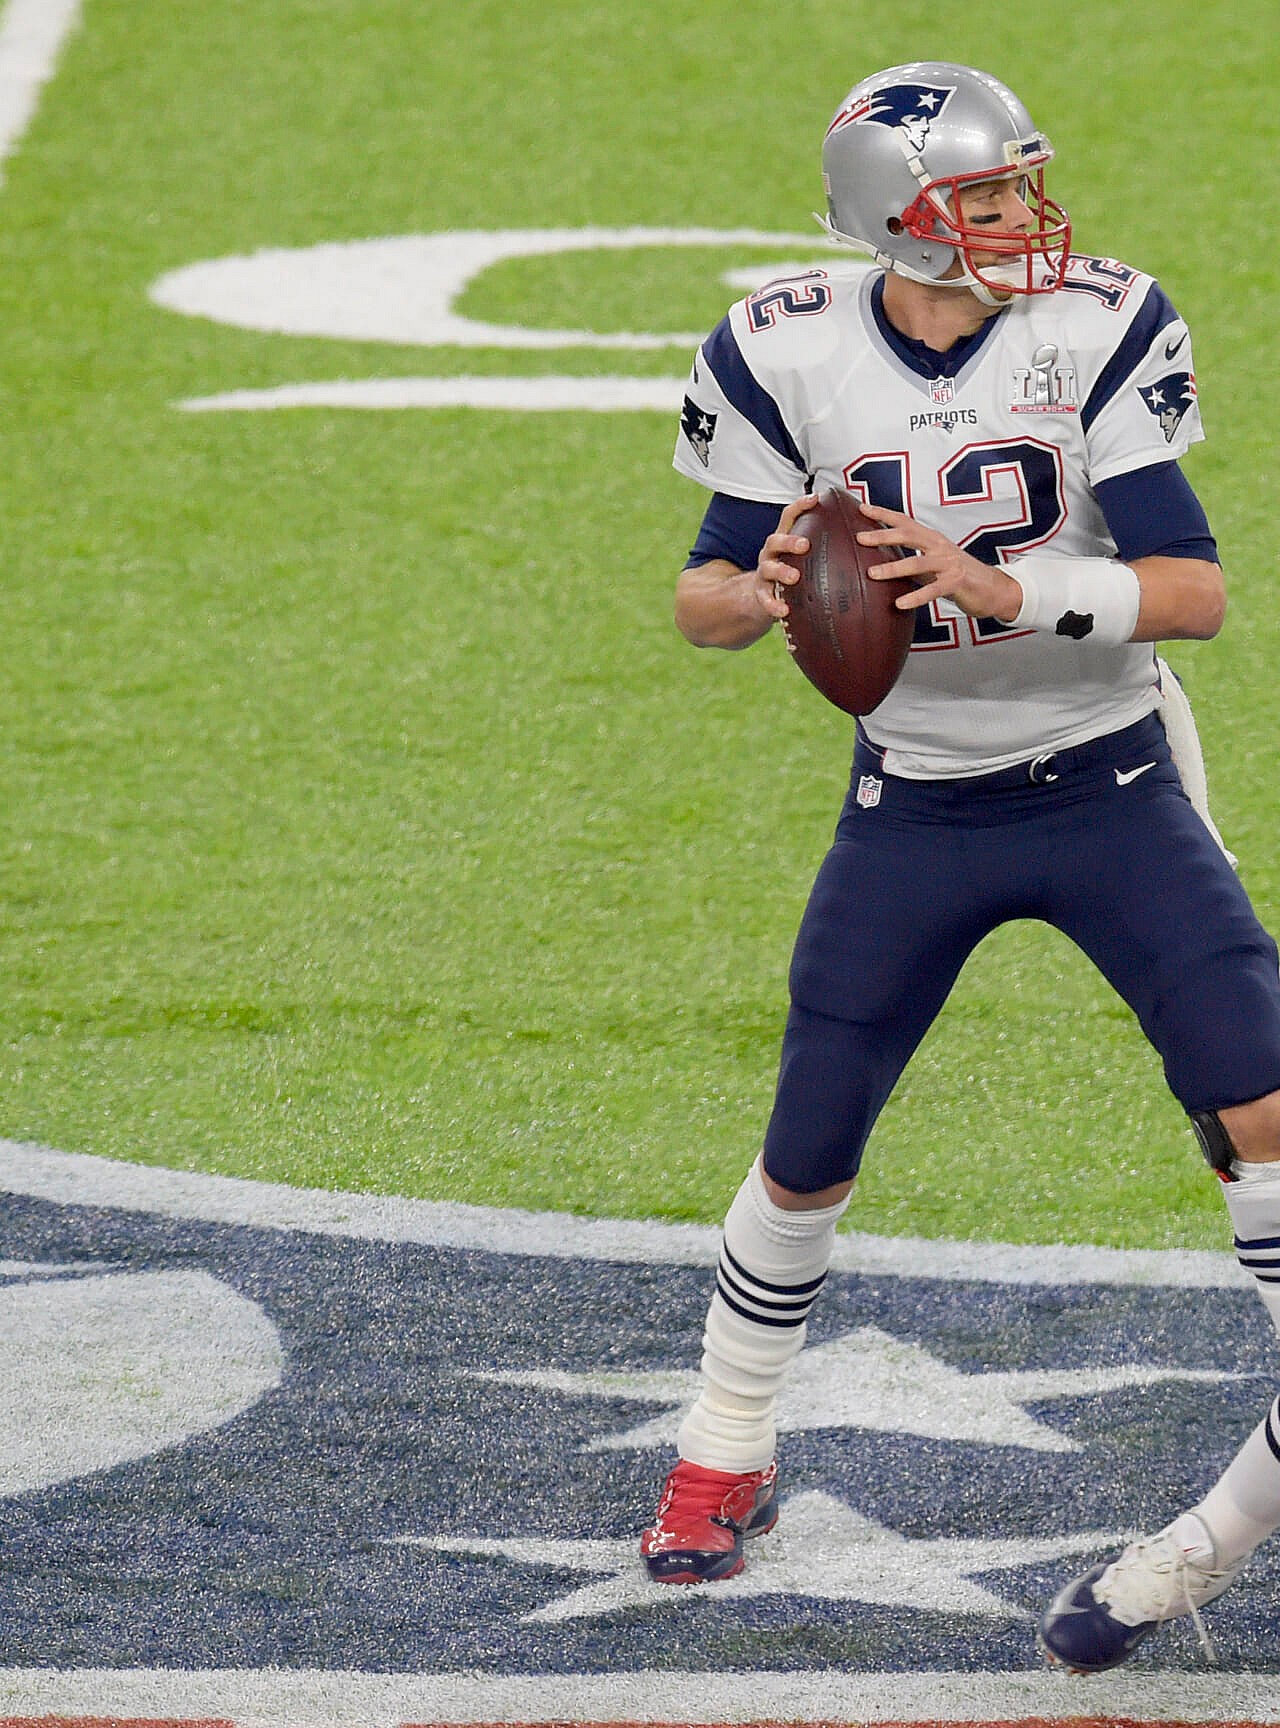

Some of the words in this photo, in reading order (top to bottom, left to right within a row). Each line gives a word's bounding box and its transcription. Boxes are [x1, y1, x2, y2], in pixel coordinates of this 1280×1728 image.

[745, 269, 833, 334] 12
[1041, 251, 1142, 313] 12
[909, 408, 978, 431] PATRIOTS
[933, 389, 952, 402] NFL
[842, 435, 1069, 653] 12
